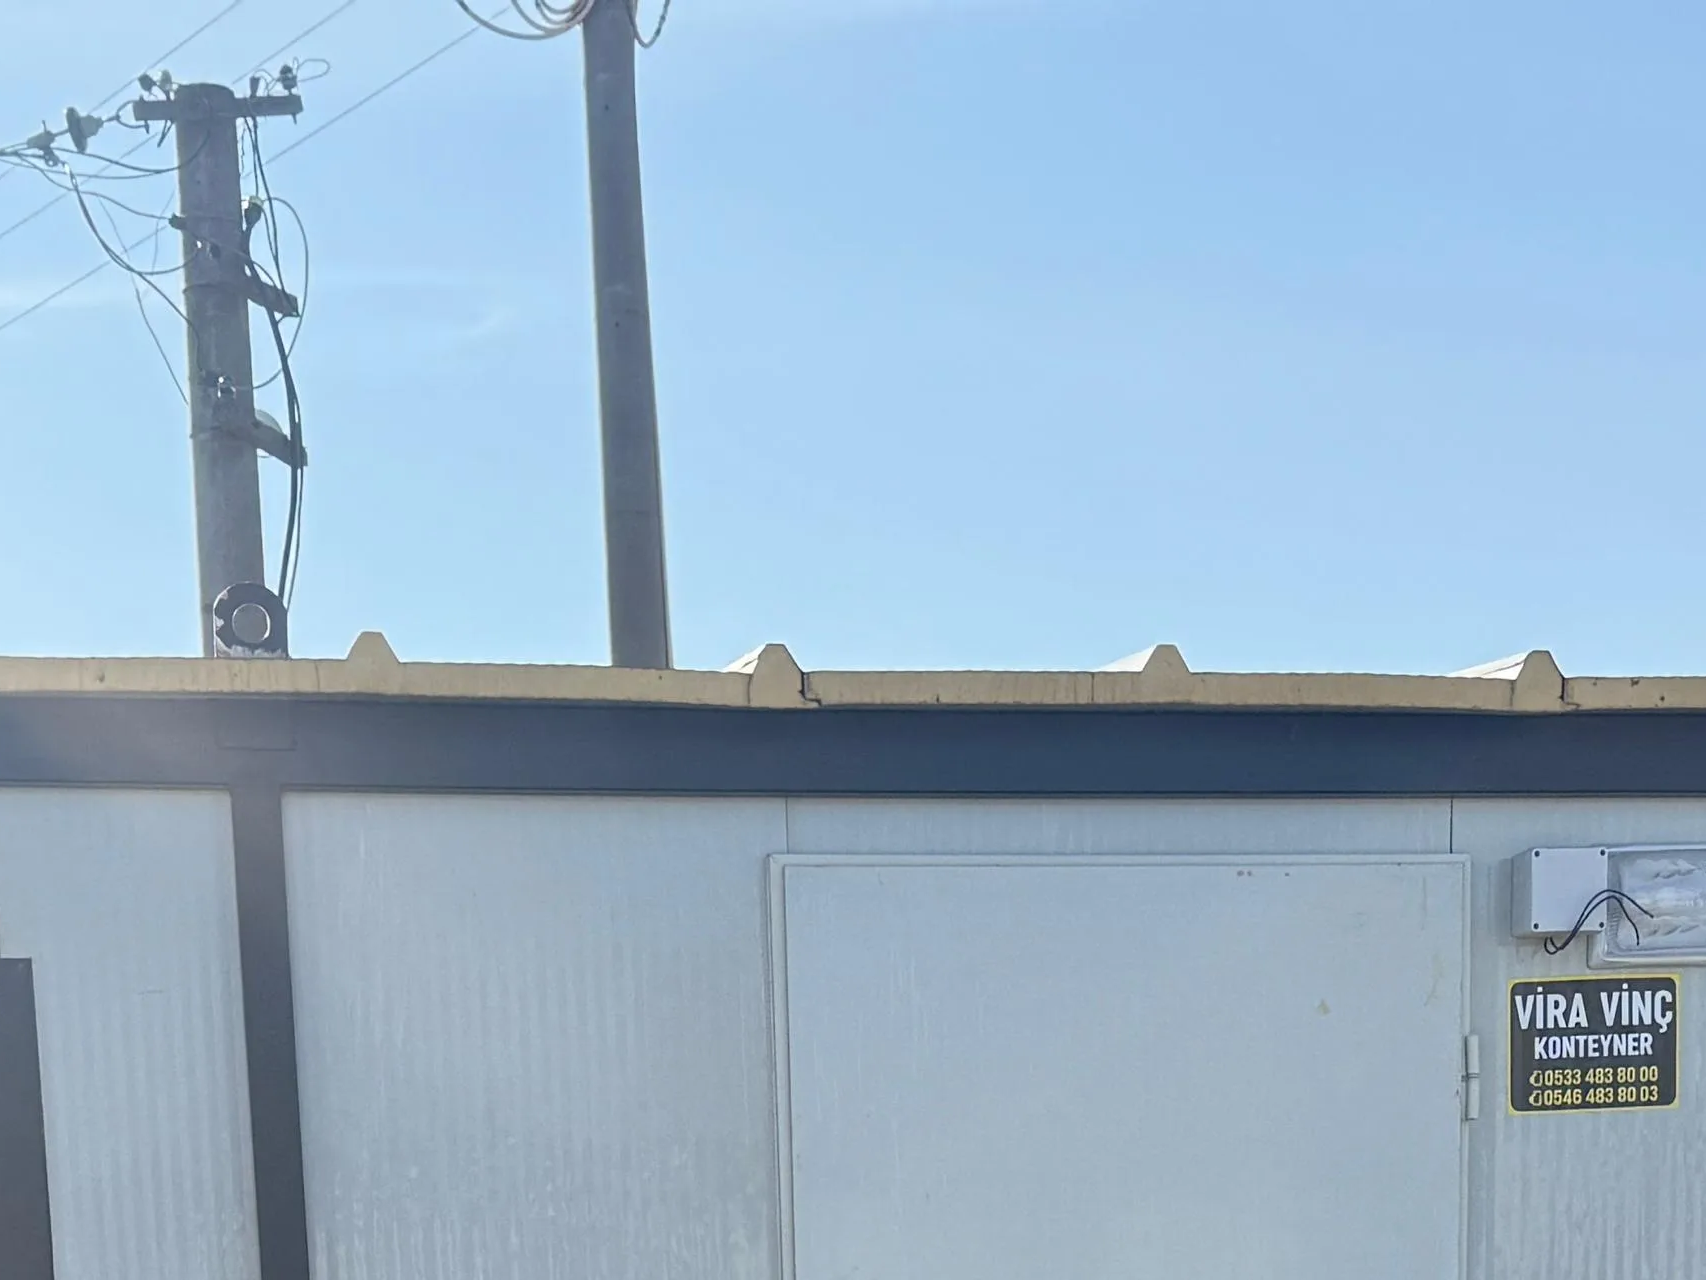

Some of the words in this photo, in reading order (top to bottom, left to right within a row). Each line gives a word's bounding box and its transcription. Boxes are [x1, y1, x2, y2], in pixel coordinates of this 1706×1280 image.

[1514, 986, 1588, 1030] VİRA
[1600, 983, 1673, 1033] VİNÇ
[1534, 1033, 1653, 1060] KONTEYNER
[1544, 1069, 1581, 1086] 0533
[1585, 1068, 1613, 1085] 483
[1617, 1066, 1634, 1083] 80
[1640, 1065, 1658, 1082] 00
[1544, 1088, 1581, 1106] 0546
[1585, 1087, 1613, 1104] 483
[1617, 1086, 1634, 1102] 80
[1640, 1085, 1658, 1102] 03
